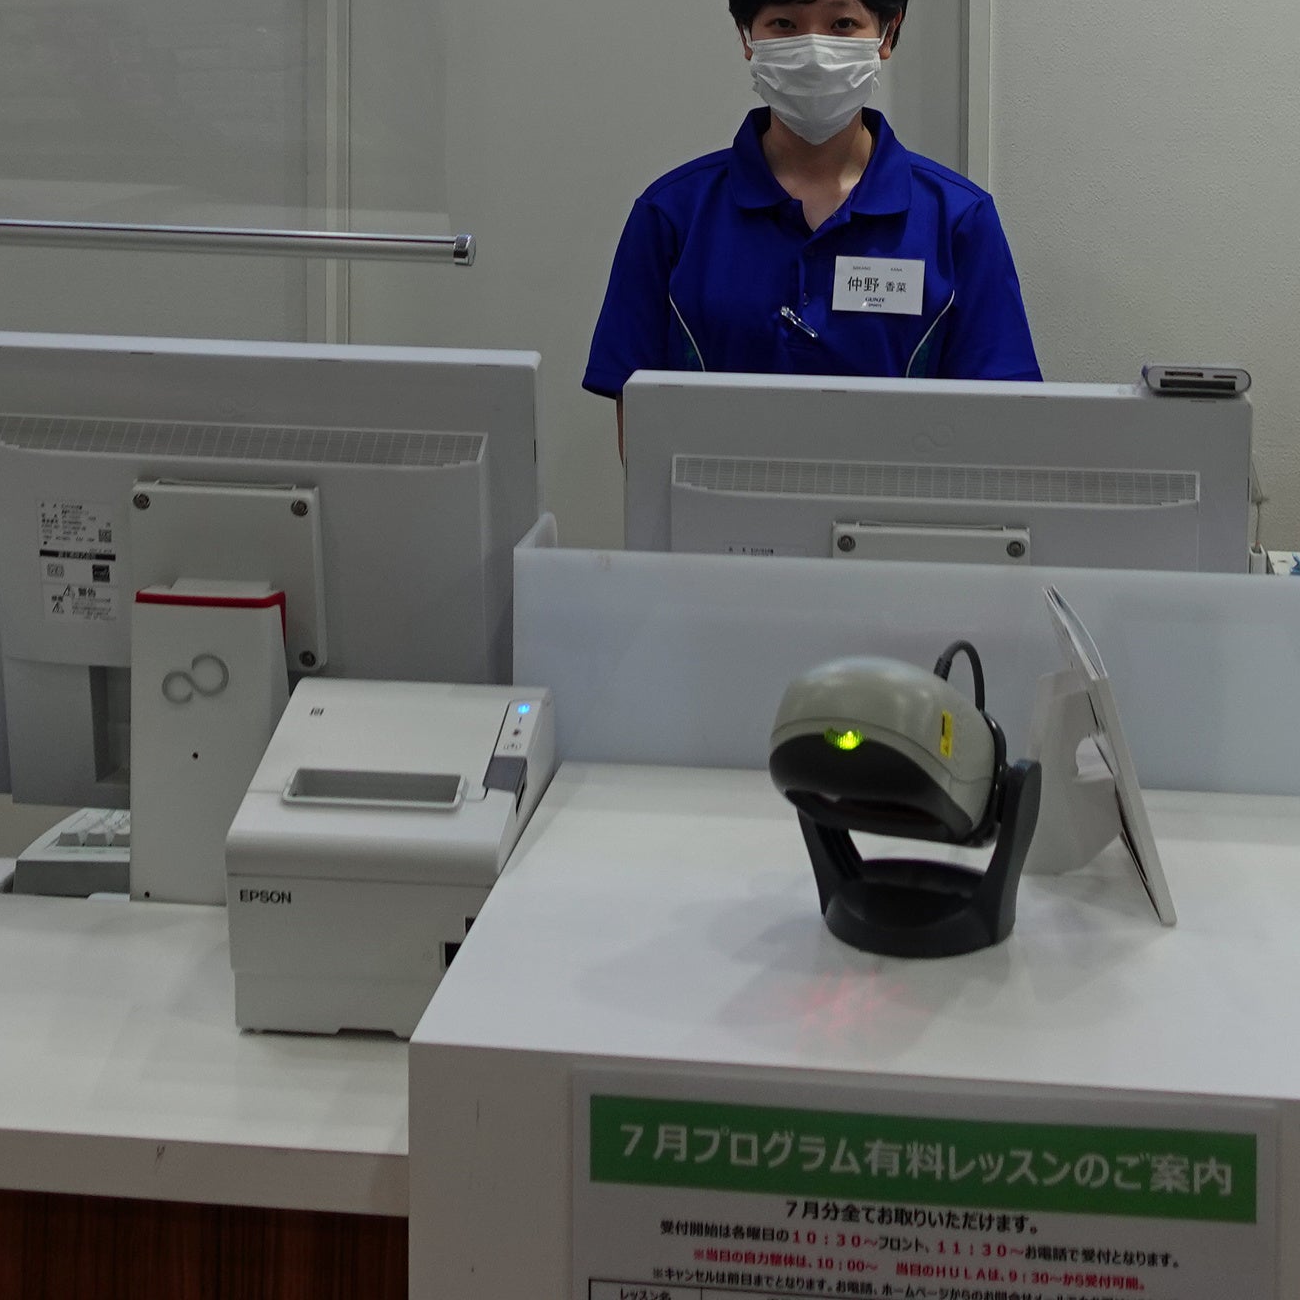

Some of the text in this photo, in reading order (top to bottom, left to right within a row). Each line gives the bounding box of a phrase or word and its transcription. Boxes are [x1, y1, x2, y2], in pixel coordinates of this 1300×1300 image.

[847, 276, 880, 293] 仲野
[239, 888, 292, 904] EPSON
[618, 1122, 1233, 1197] 7月プログラム有料レッスンのご案内
